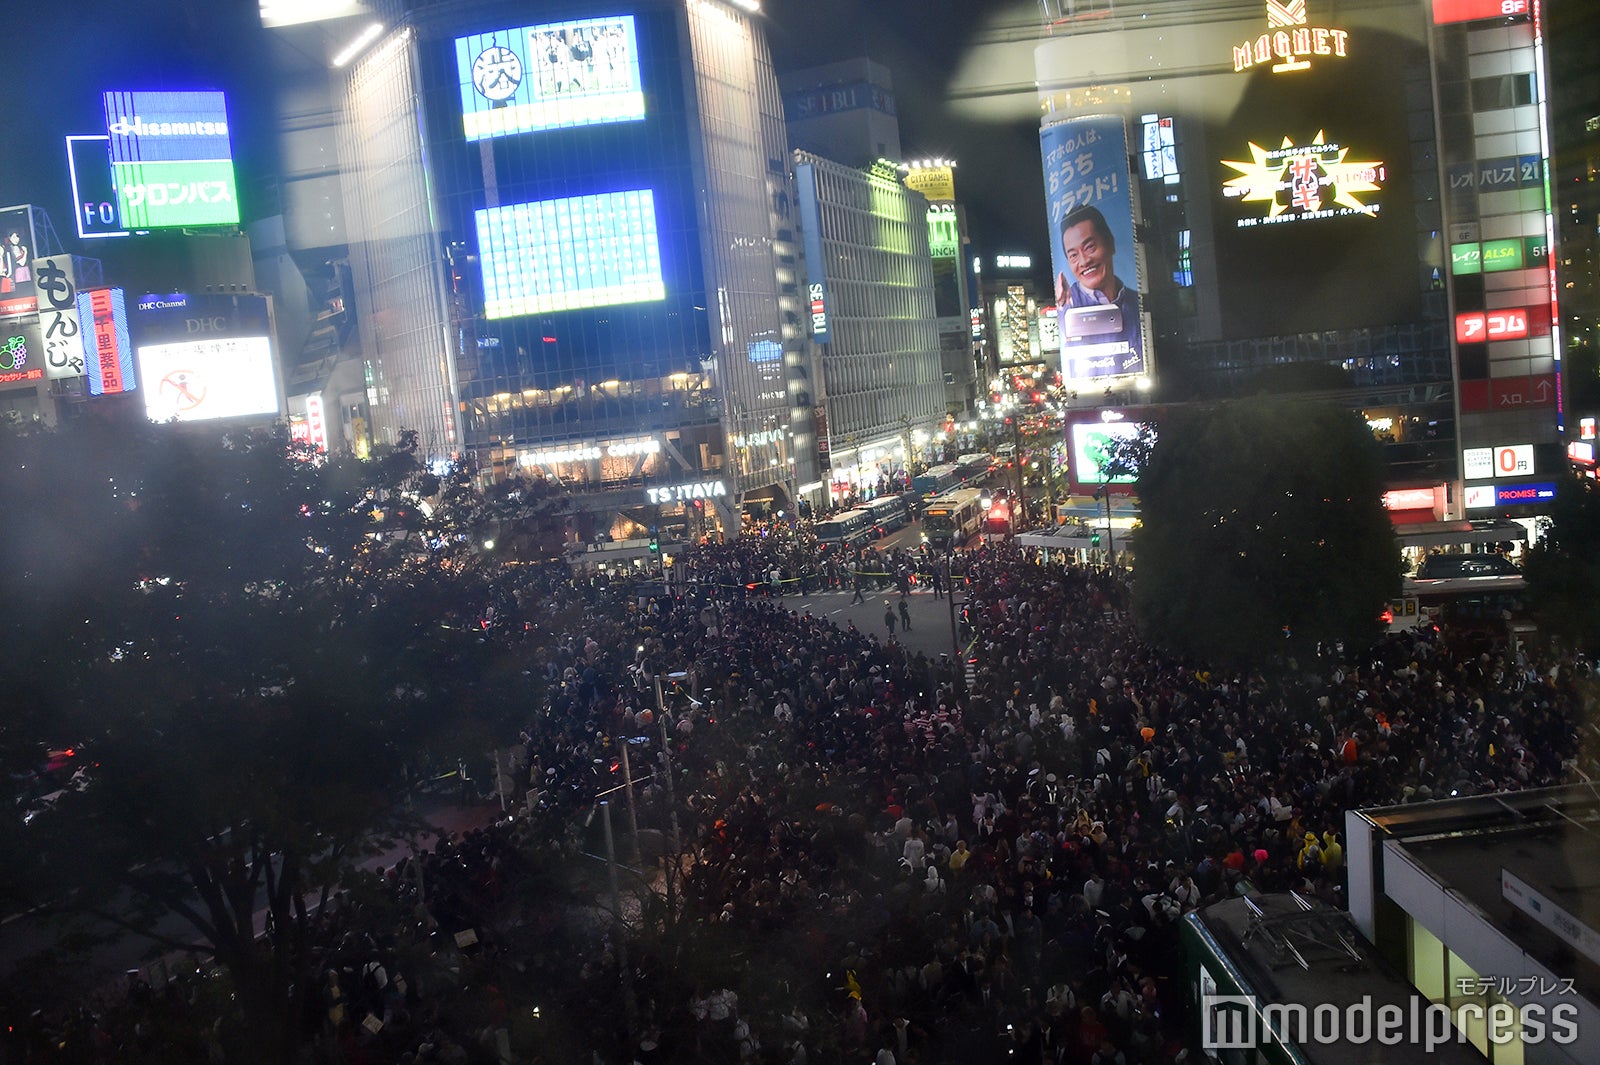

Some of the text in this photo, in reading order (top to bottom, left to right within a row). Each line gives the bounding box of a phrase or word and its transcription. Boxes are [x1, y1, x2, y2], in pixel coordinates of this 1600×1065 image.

[1501, 0, 1525, 14] 8F
[1232, 28, 1348, 72] MAGNET
[109, 116, 227, 136] Hisamitsu
[123, 180, 231, 207] サロンパス
[1452, 247, 1515, 263] レイク ALSA
[138, 299, 186, 310] DHC Channel
[37, 259, 85, 375] もんじゃ
[186, 317, 226, 333] DHC
[1464, 314, 1526, 337] アコム
[92, 294, 118, 389] 三千里薬品
[1500, 394, 1523, 406] 入口
[1500, 448, 1528, 473] 0円
[1498, 489, 1537, 500] PROMISE
